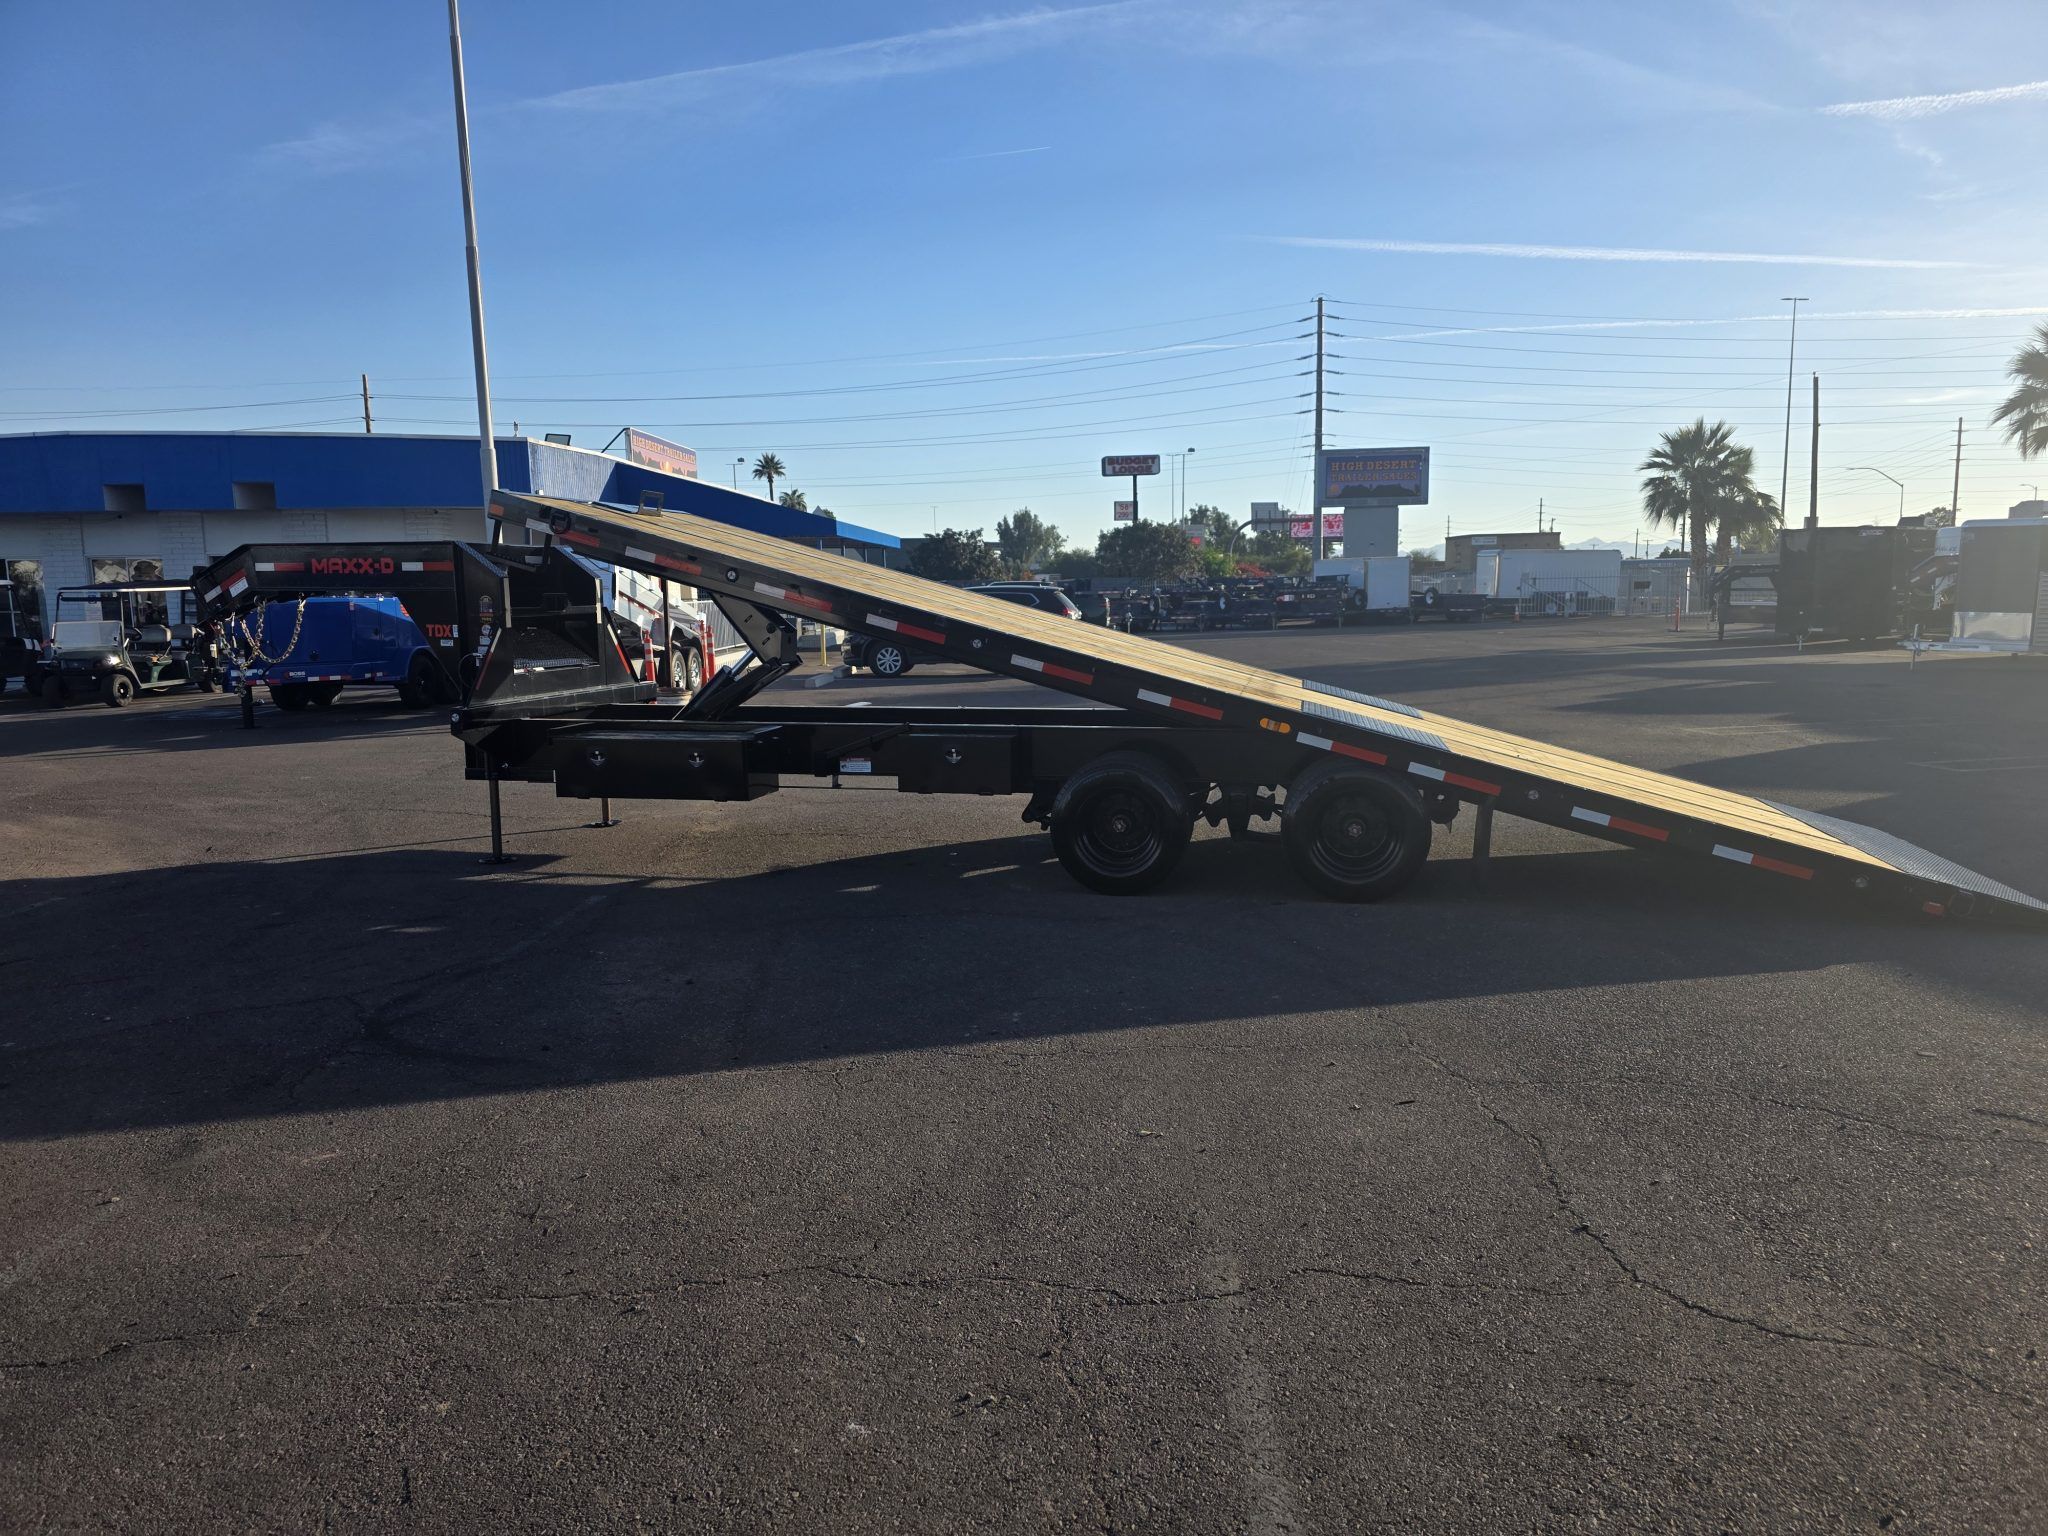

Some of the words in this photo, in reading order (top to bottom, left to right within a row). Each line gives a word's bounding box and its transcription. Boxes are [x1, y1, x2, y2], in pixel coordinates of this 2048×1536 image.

[1107, 456, 1157, 466] BUDGET
[1331, 461, 1363, 471] HIGH
[1367, 460, 1417, 470] DESERT
[1112, 465, 1153, 474] LODGE
[1383, 471, 1417, 481] SALES
[311, 557, 394, 574] MAXX-D
[426, 624, 452, 637] TDX
